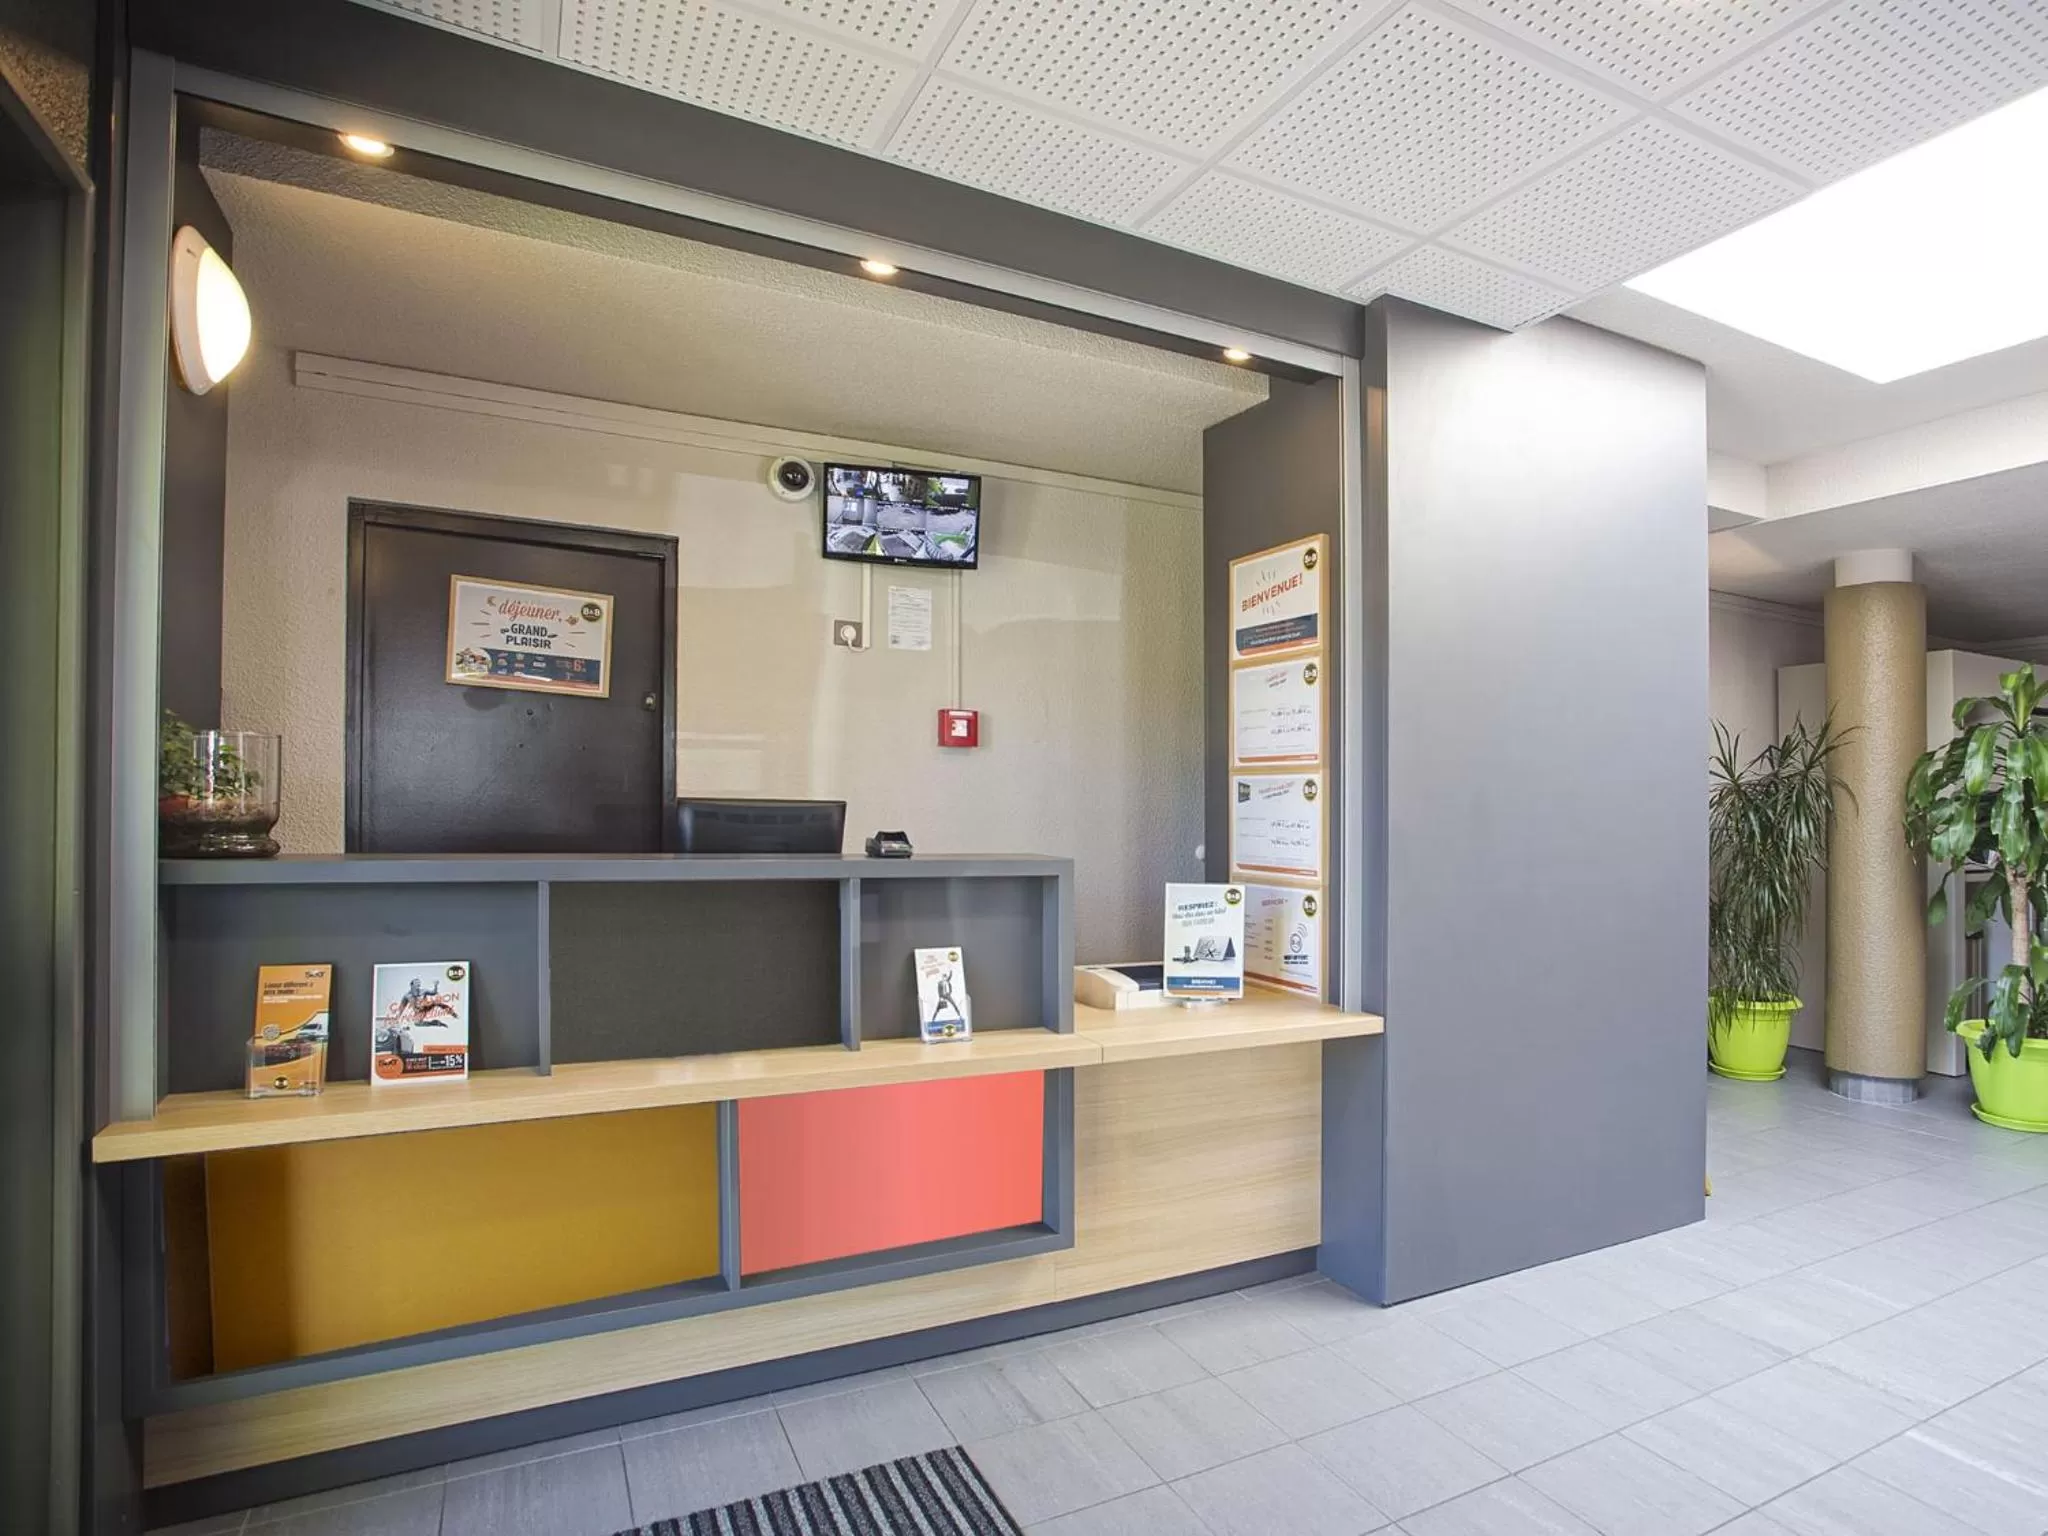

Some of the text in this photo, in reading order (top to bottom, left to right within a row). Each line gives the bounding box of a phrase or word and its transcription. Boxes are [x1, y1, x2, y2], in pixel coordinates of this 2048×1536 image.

[1241, 572, 1303, 612] BIENVENUE!
[510, 623, 548, 638] GRAND
[505, 635, 552, 649] PLAISIR
